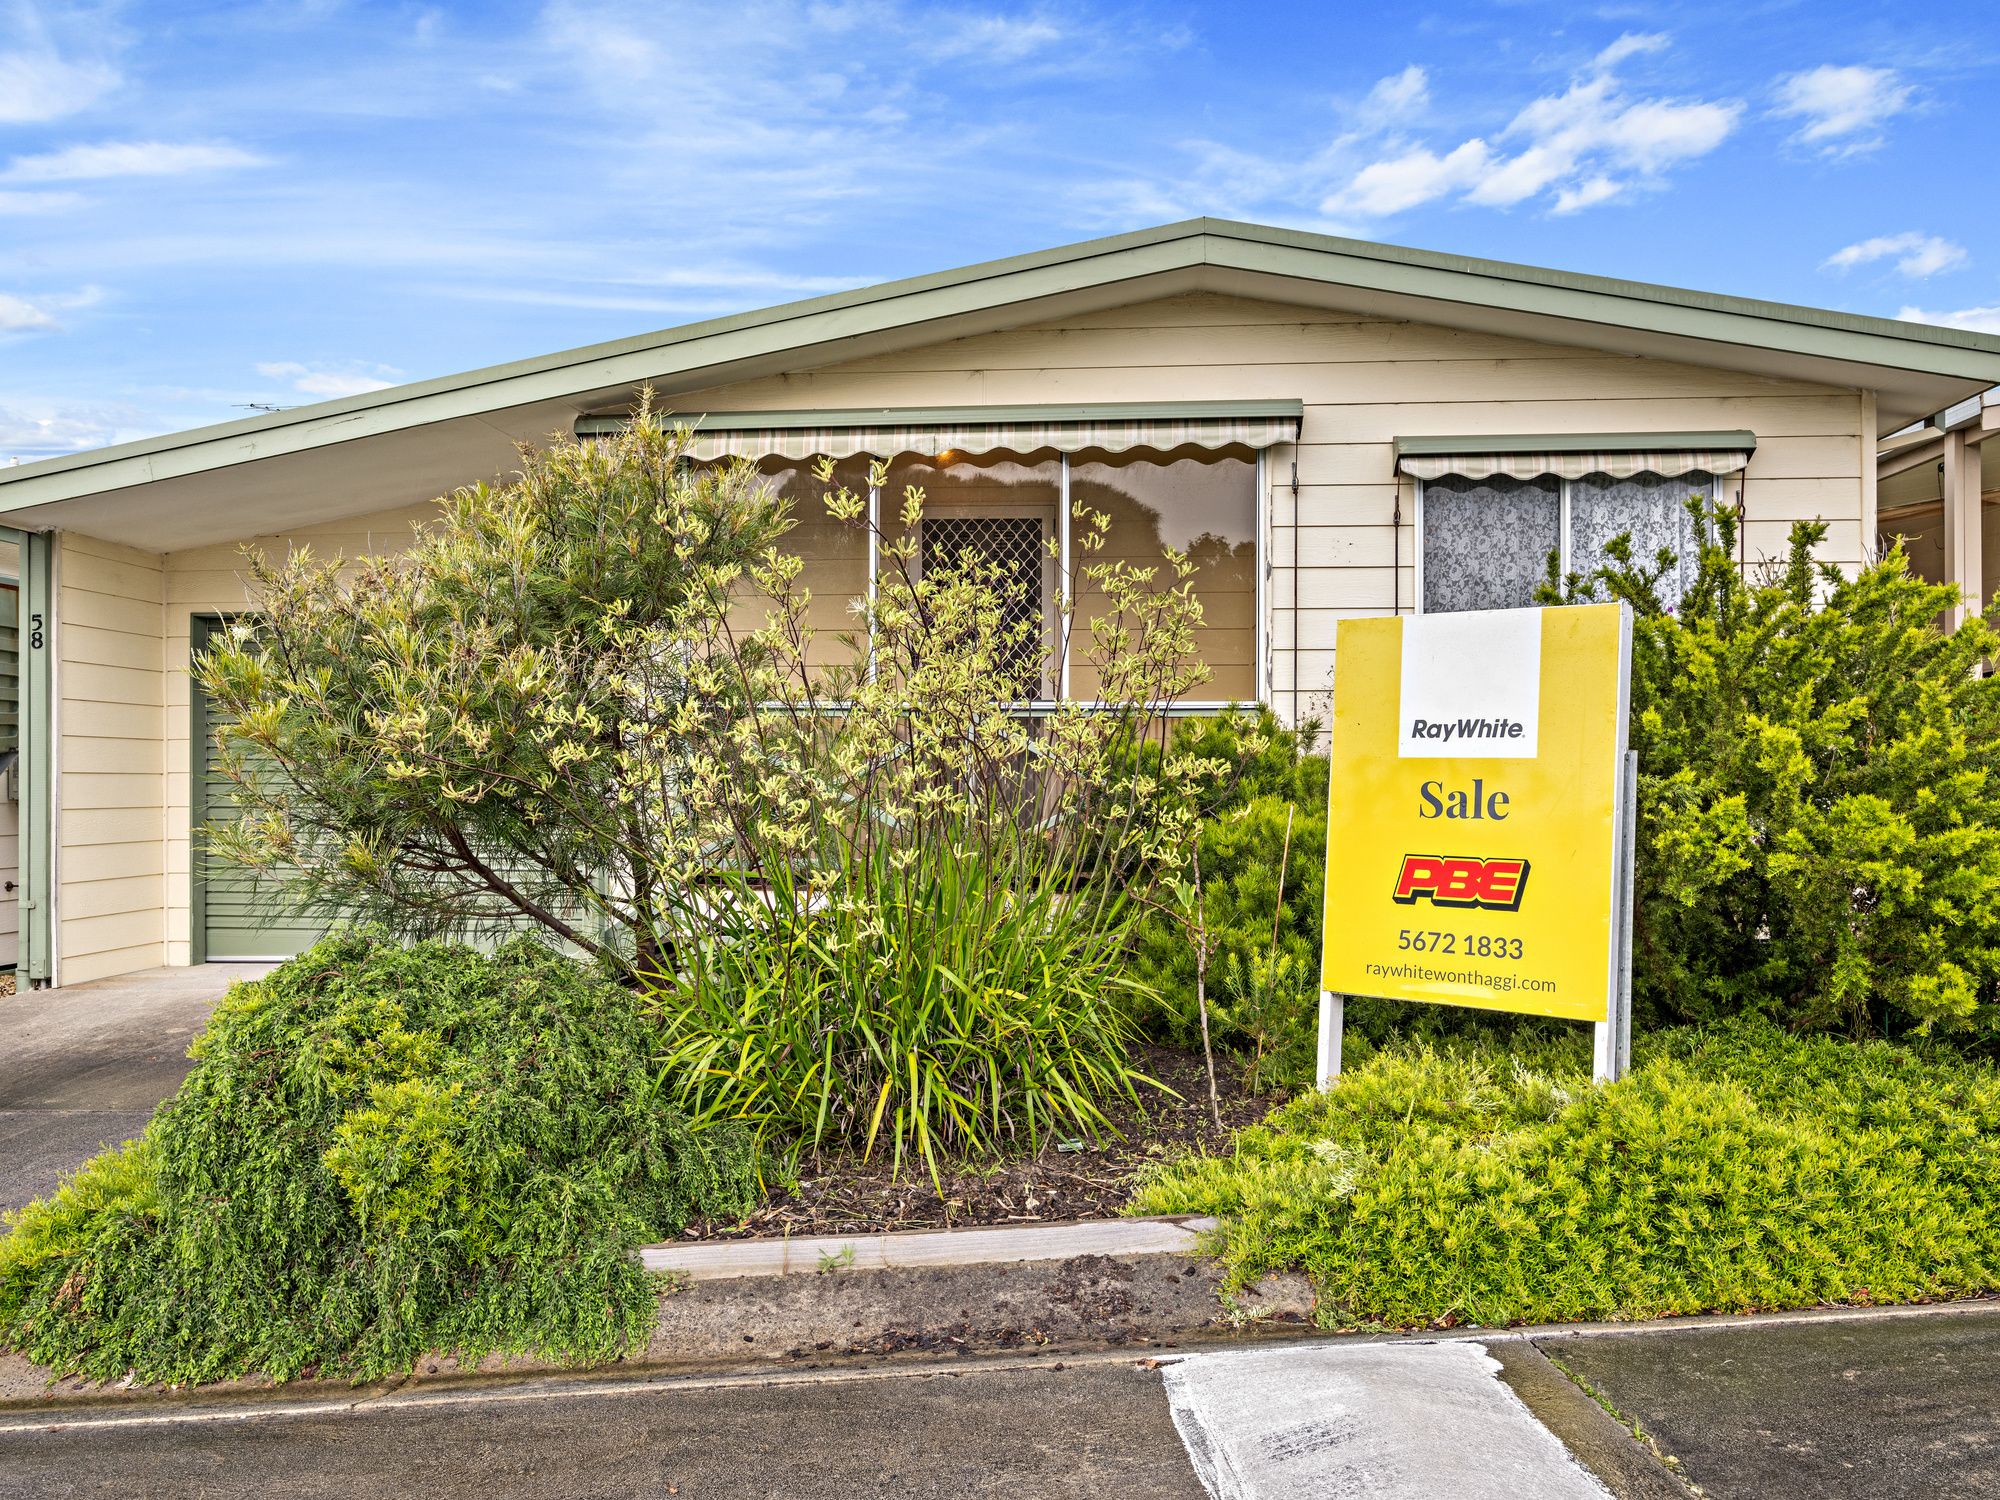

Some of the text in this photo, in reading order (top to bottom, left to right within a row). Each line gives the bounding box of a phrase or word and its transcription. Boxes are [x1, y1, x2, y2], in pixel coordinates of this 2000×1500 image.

[31, 613, 43, 650] 58
[1418, 778, 1510, 821] Sale
[1394, 856, 1524, 905] PBE
[1398, 929, 1524, 960] 5672 1833
[1365, 963, 1557, 993] raywhitewonthaggi.com
